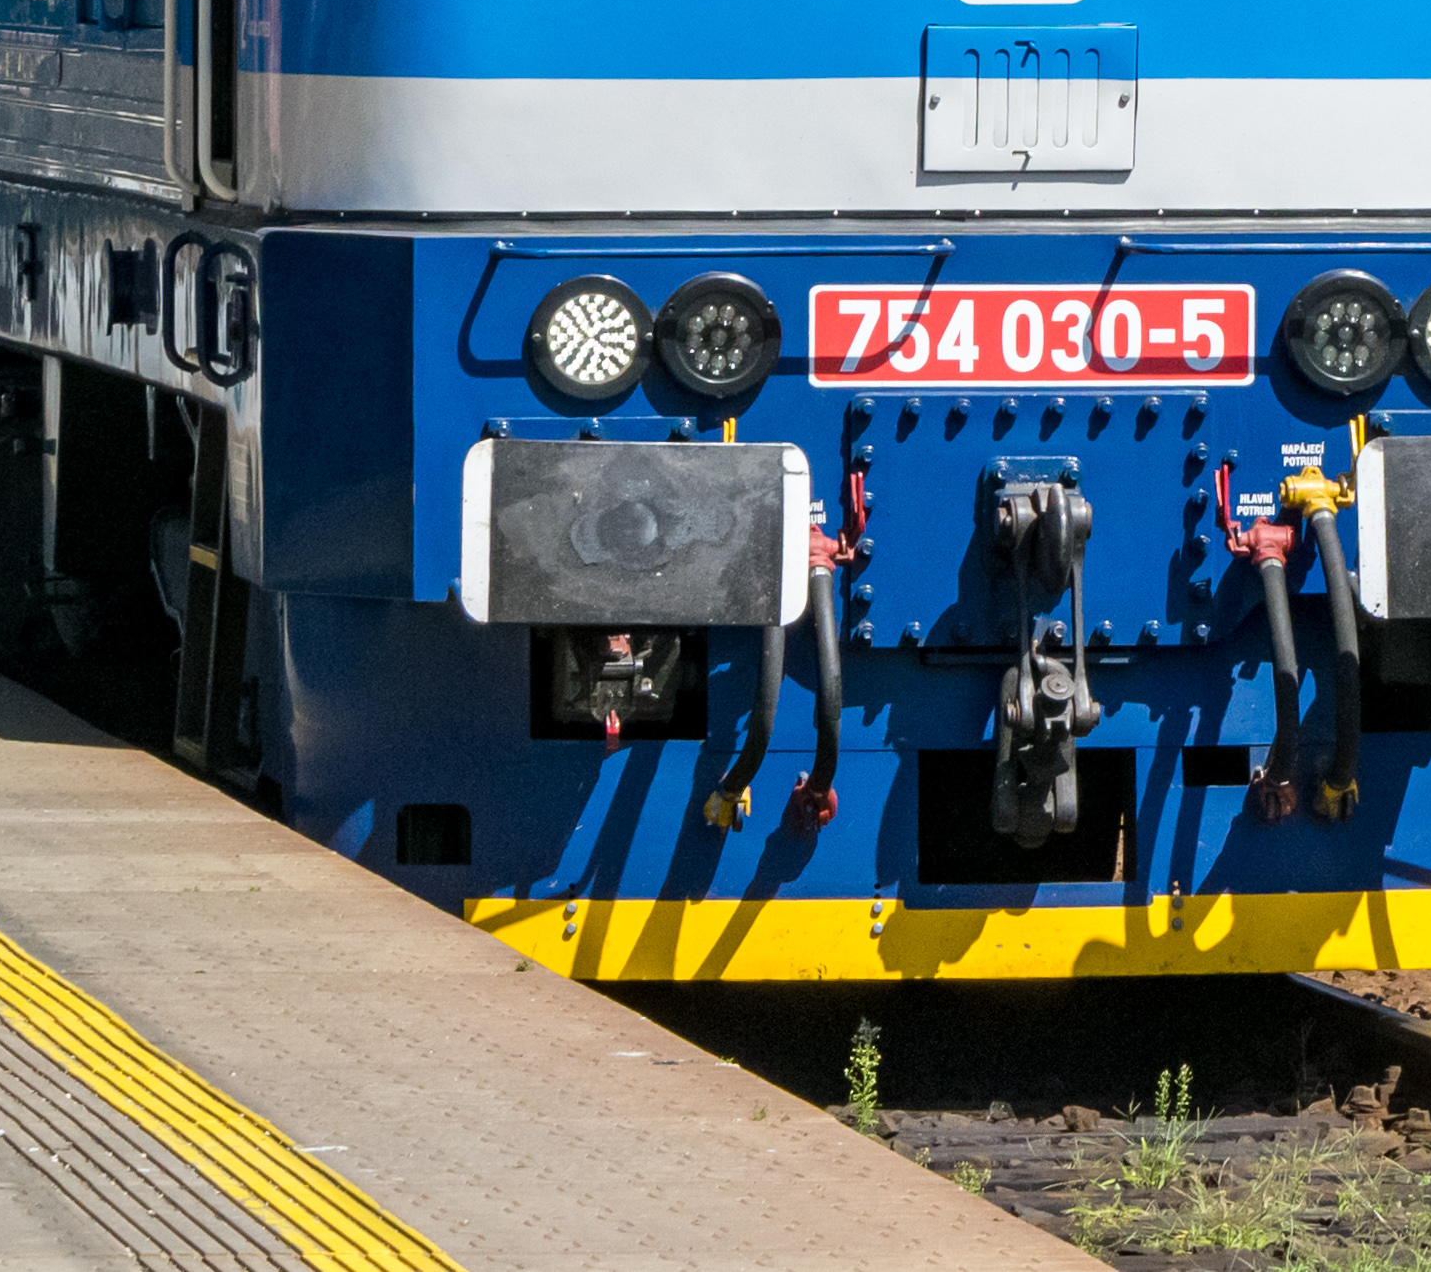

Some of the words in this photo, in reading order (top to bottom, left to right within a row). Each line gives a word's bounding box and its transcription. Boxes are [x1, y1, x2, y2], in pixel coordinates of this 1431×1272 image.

[838, 299, 979, 373] 754
[1001, 299, 1225, 373] 030-5
[1281, 441, 1325, 455] NAPÁJECÍ
[1283, 454, 1322, 467] POTRUBÍ
[1239, 491, 1273, 504] HLAVNÍ
[1236, 504, 1275, 516] POTRUBÍ
